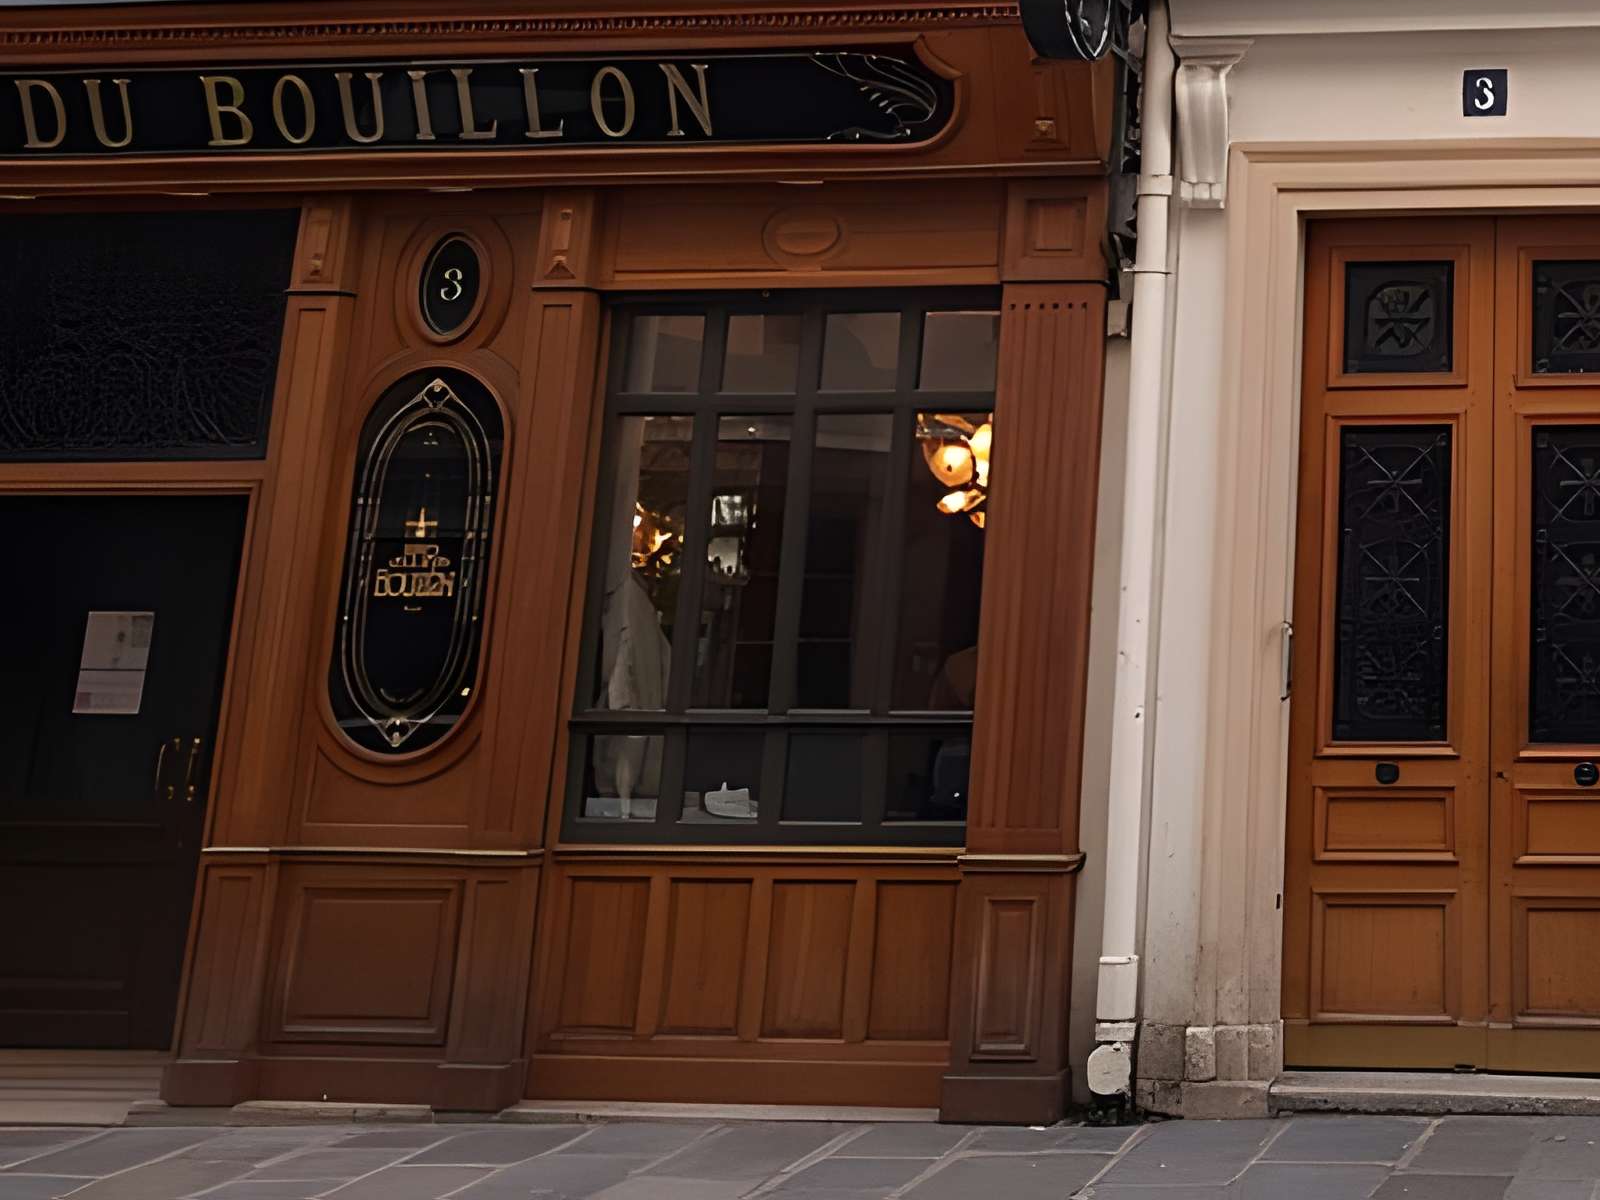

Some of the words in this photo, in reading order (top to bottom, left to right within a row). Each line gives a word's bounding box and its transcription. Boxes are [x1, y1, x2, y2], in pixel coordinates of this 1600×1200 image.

[14, 77, 134, 149] DU
[200, 63, 713, 147] BOUILLON
[1475, 77, 1495, 110] 3
